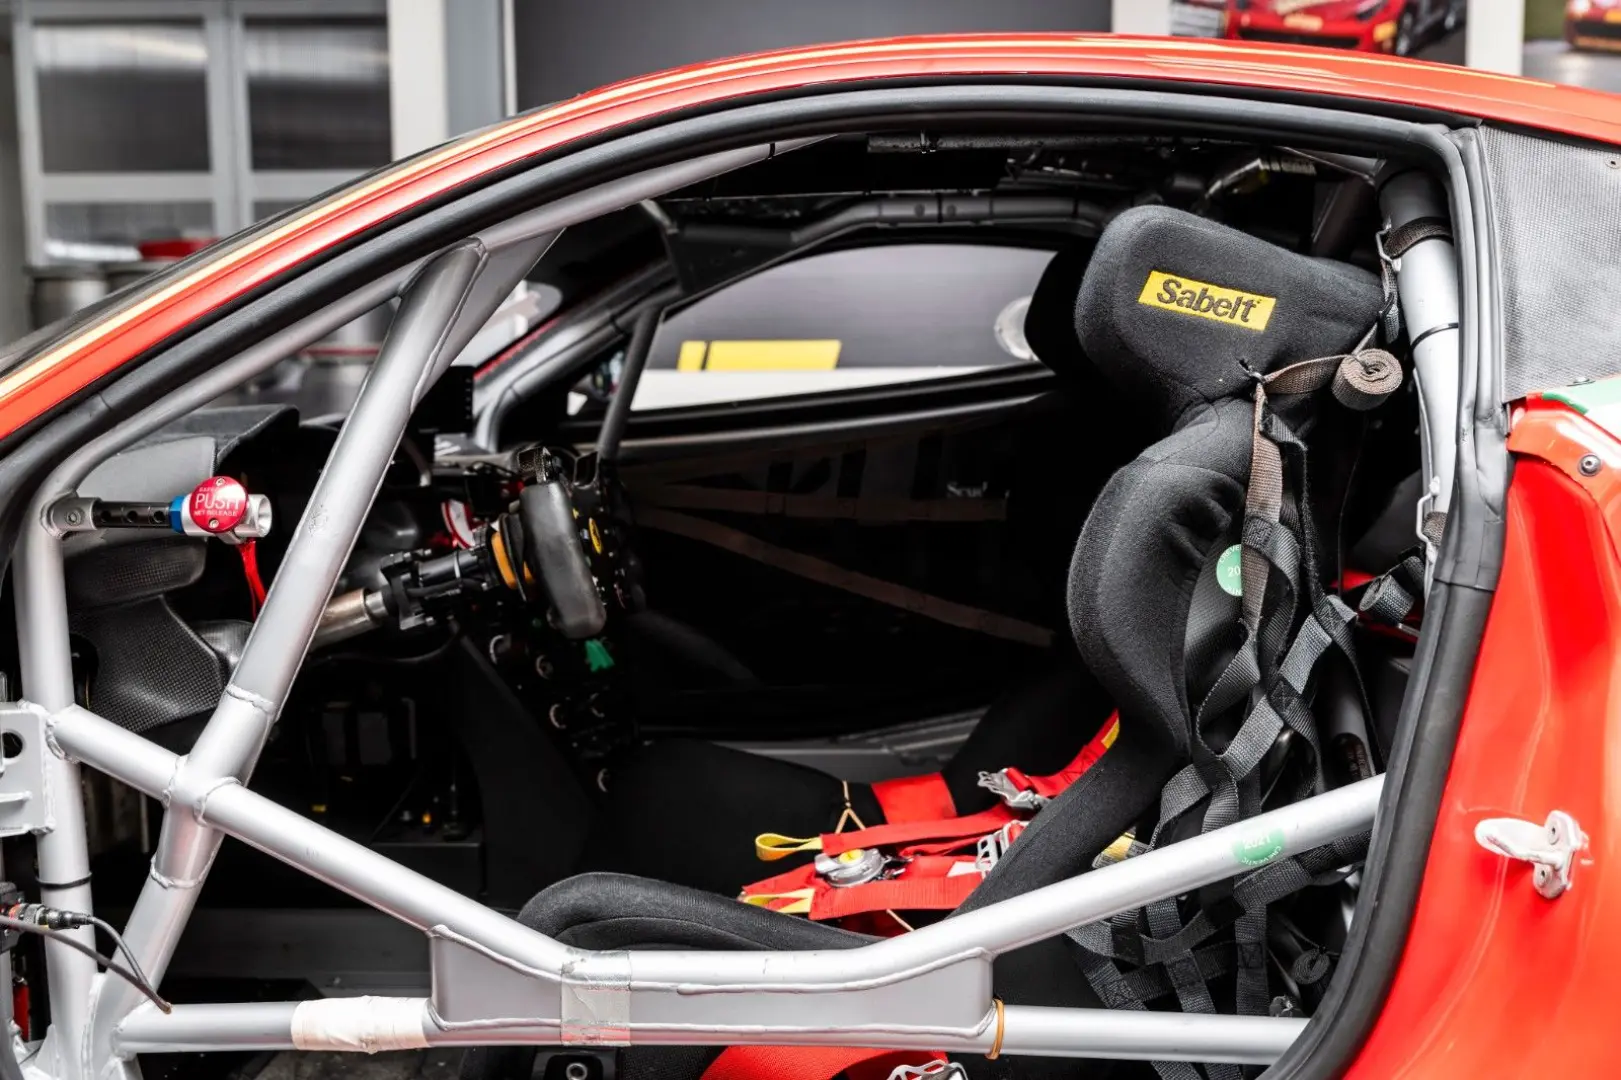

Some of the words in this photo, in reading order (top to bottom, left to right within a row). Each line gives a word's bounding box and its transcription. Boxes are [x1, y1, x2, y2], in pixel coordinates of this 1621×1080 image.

[1156, 278, 1257, 323] Sabelt
[195, 493, 240, 510] PUSH
[1227, 564, 1241, 578] 20
